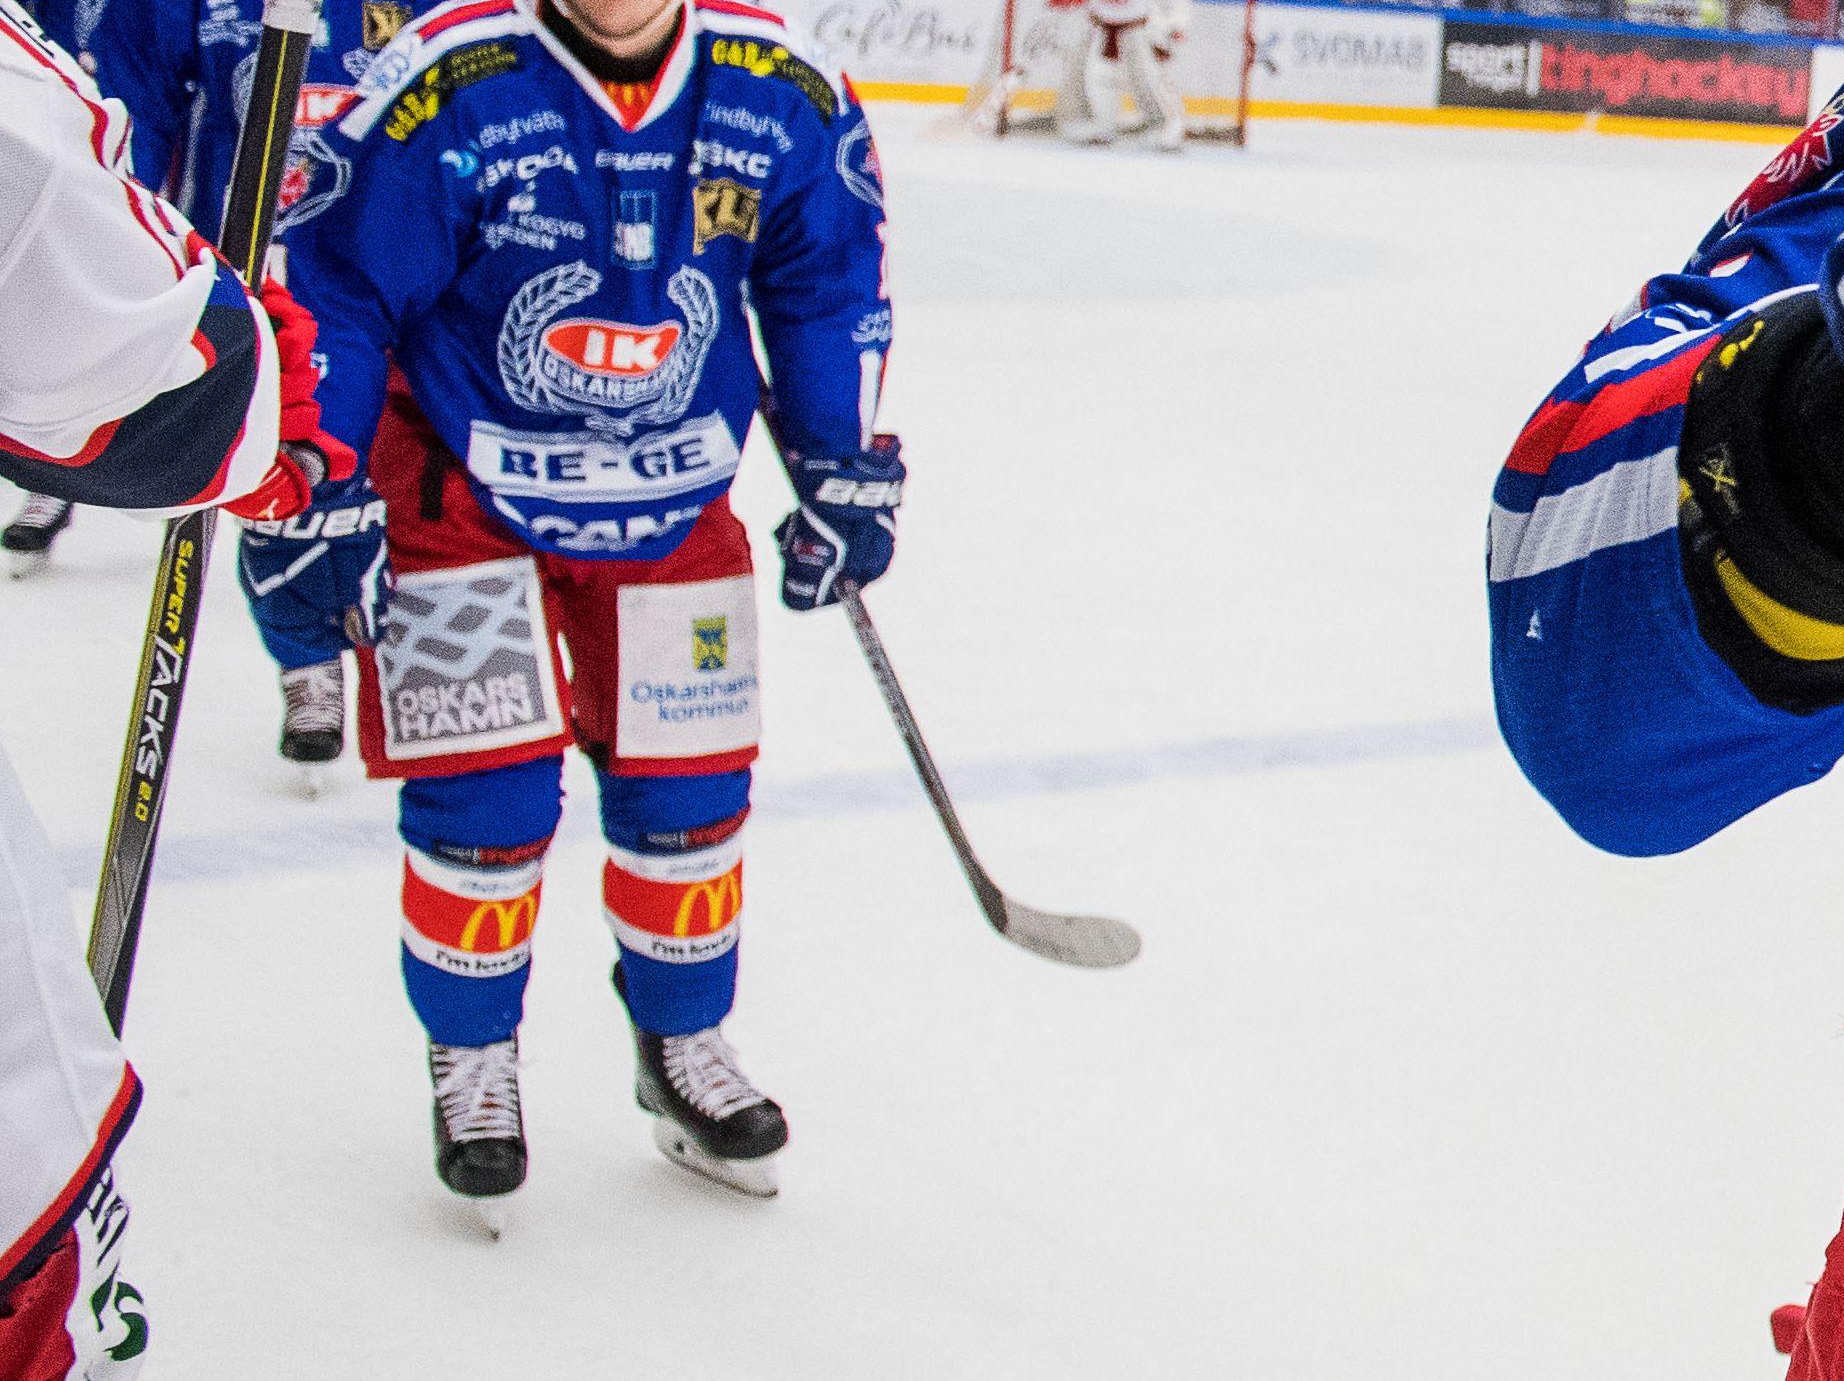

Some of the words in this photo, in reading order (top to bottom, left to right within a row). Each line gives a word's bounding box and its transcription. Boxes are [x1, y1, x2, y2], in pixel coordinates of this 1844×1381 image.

[582, 327, 662, 370] IK
[499, 436, 712, 484] BE-GE
[164, 538, 195, 635] SUPER
[135, 633, 186, 779] TACKS
[398, 672, 530, 716] OSKARS
[400, 697, 534, 740] HAMN
